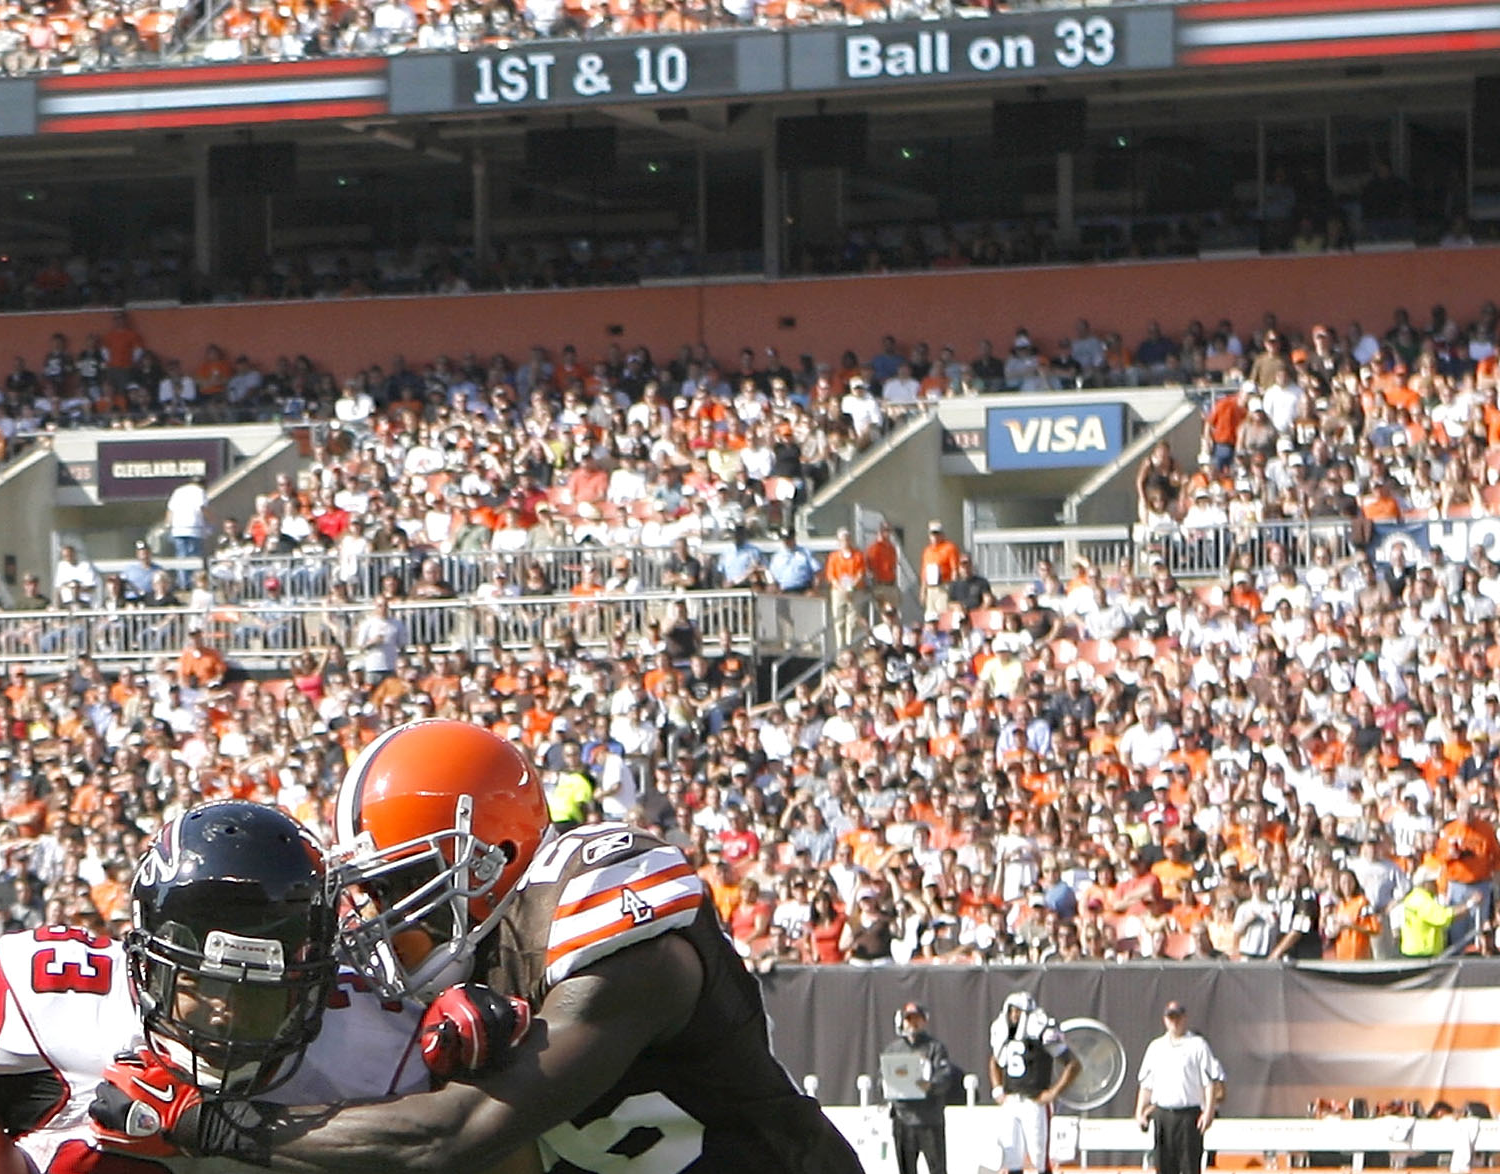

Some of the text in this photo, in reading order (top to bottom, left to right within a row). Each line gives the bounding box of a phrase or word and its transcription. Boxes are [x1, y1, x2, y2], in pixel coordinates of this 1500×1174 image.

[474, 45, 688, 104] 1ST & 10
[846, 16, 1116, 78] Ball on 33
[1003, 415, 1107, 454] VISA
